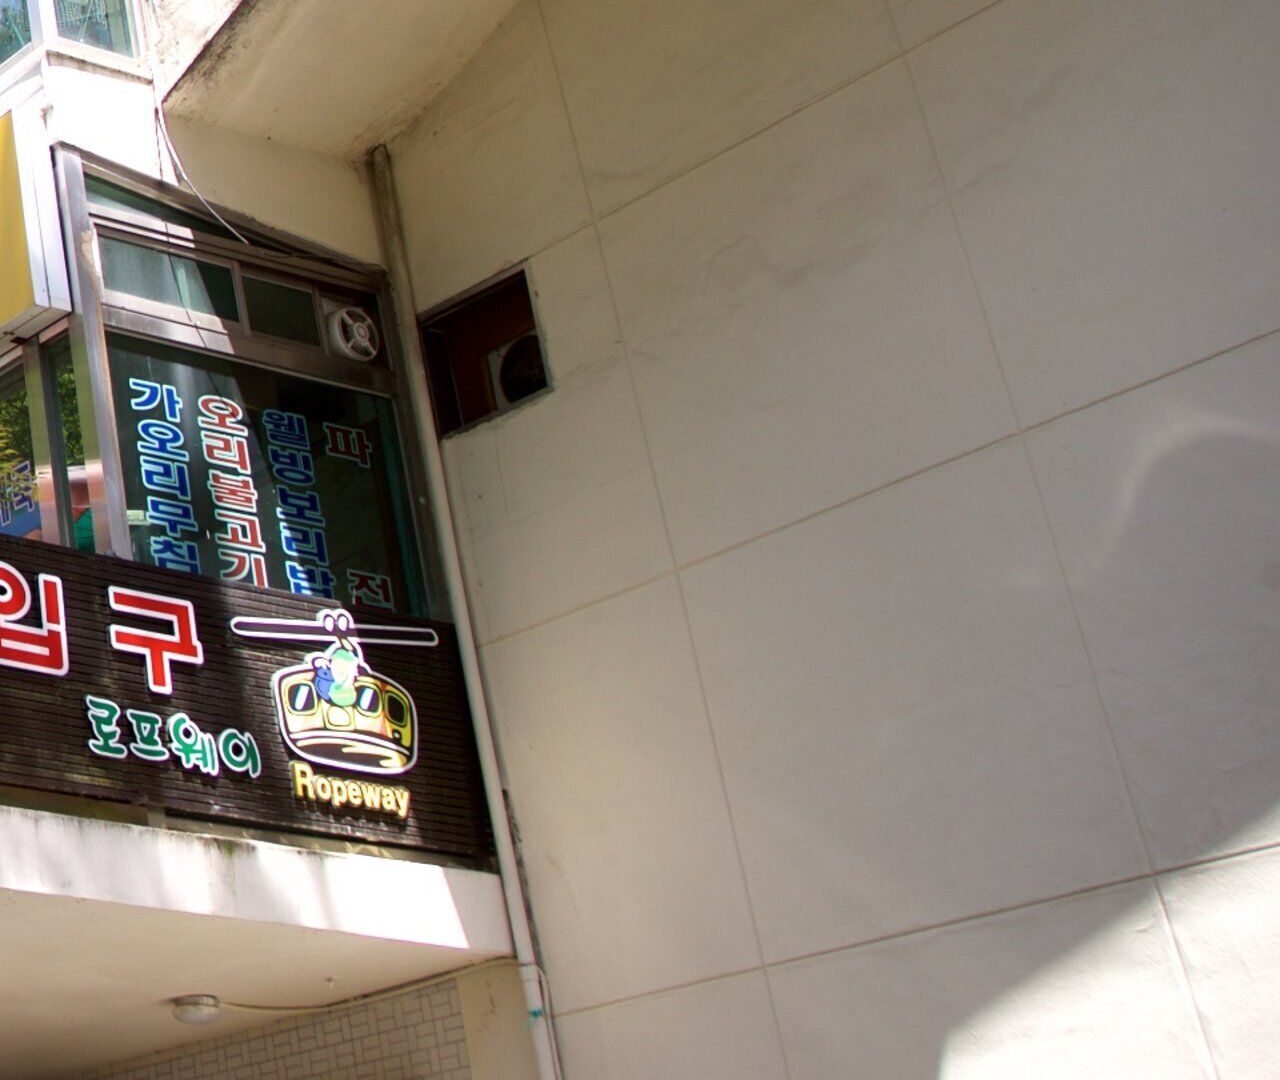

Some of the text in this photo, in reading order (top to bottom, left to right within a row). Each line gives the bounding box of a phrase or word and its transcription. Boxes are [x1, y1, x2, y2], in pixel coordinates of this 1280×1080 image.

[129, 377, 202, 575] 가오리무침
[197, 394, 269, 589] 오리불고기
[85, 694, 262, 780] 로프웨이
[290, 761, 410, 819] Ropeway
